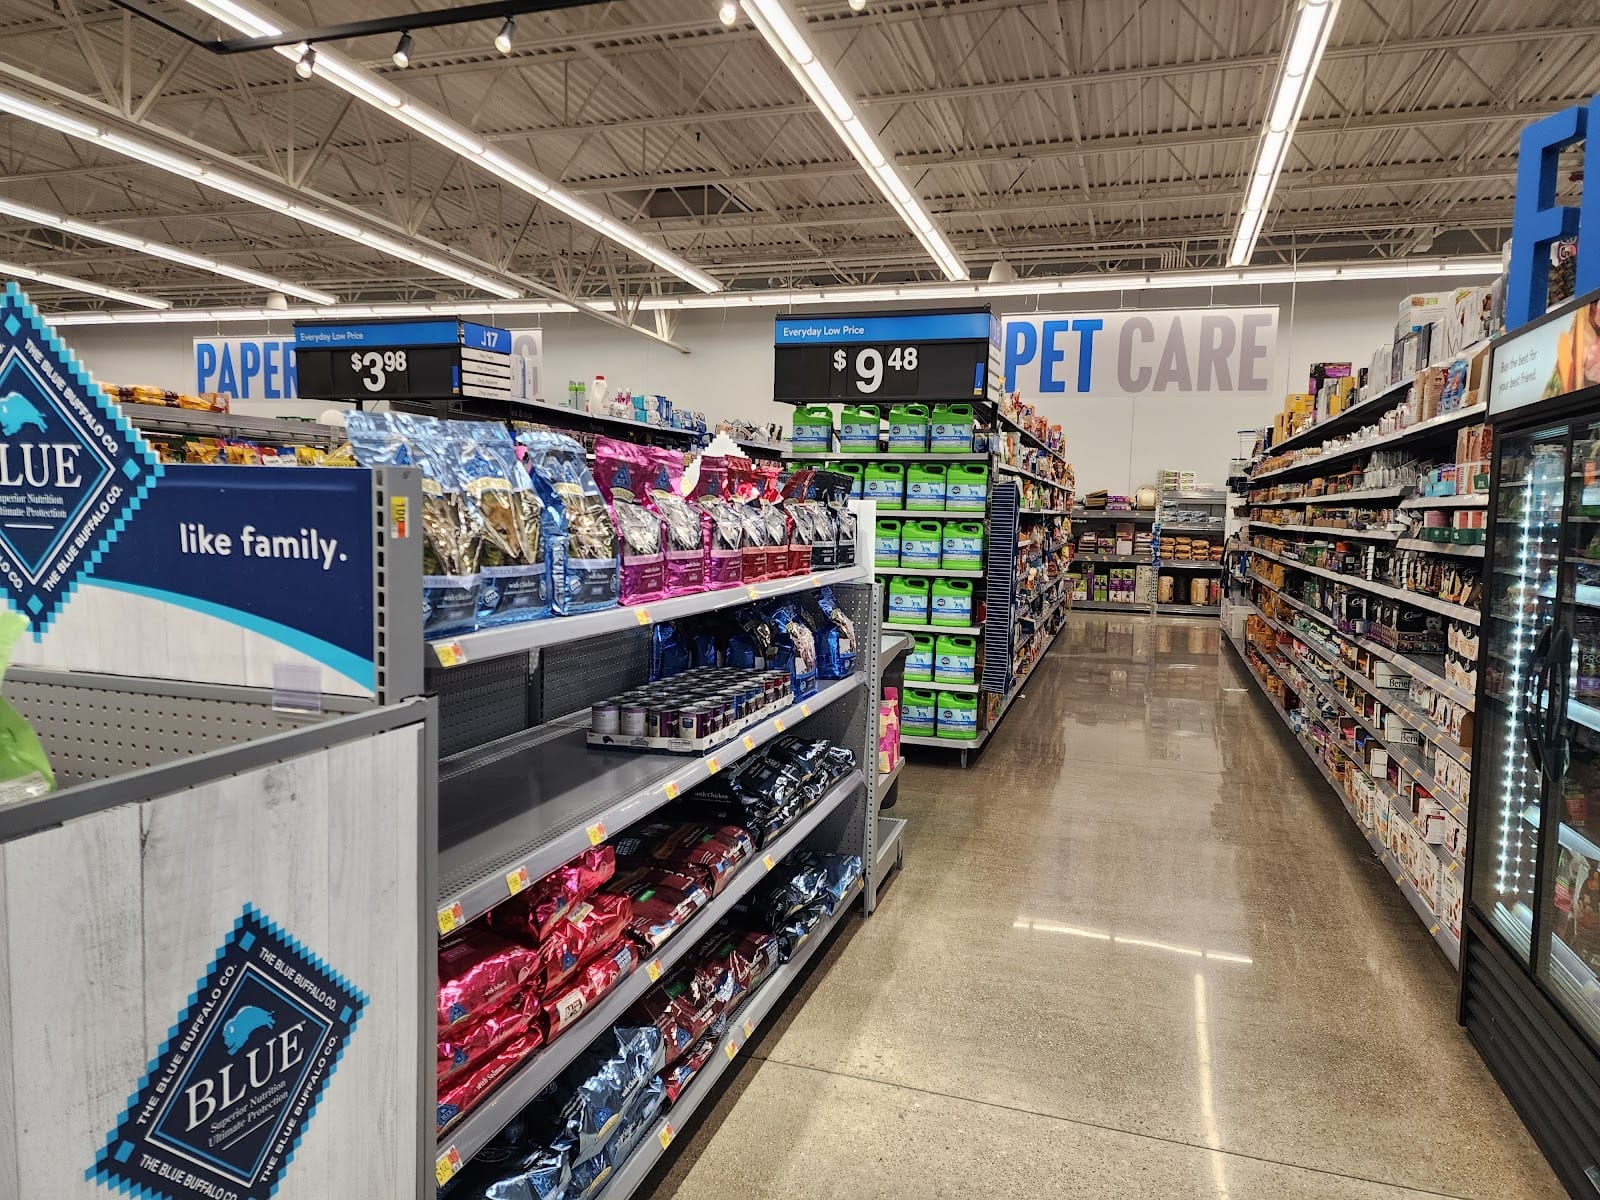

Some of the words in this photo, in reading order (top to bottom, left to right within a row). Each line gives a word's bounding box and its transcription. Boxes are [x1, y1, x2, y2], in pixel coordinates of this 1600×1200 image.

[300, 332, 331, 344] Everyday
[332, 332, 346, 341] Low
[346, 331, 364, 340] Price
[480, 330, 498, 348] J17
[784, 327, 822, 341] Everyday
[824, 326, 841, 336] Low
[843, 325, 864, 335] Price
[1004, 319, 1103, 393] PET
[1117, 314, 1273, 393] CARE
[40, 359, 67, 392] BLUE
[63, 386, 104, 437] BUFFALO
[42, 570, 62, 592] THE
[56, 545, 79, 573] BLUE
[74, 502, 110, 549] BUFFALO
[179, 523, 232, 556] like
[240, 525, 348, 570] family.
[259, 946, 277, 966] THE
[273, 958, 297, 980] BLUE
[293, 973, 326, 1003] BUFFALO
[324, 996, 337, 1012] CO.
[136, 1096, 160, 1126] THE
[155, 1053, 185, 1094] BLUE
[180, 988, 222, 1052] BUFFALO
[219, 964, 238, 988] CO.
[185, 1021, 305, 1132] BLUE
[210, 1104, 249, 1134] Superior
[250, 1080, 286, 1109] Nutrition
[207, 1120, 246, 1148] Ultimate
[247, 1091, 289, 1123] Protection
[259, 1156, 278, 1183] THE
[275, 1118, 298, 1155] BLUE
[294, 1056, 326, 1115] BUFFALO
[324, 1035, 338, 1056] CO.
[139, 1153, 160, 1172] THE
[157, 1163, 185, 1184] BLUE
[183, 1173, 224, 1200] BUFFALO
